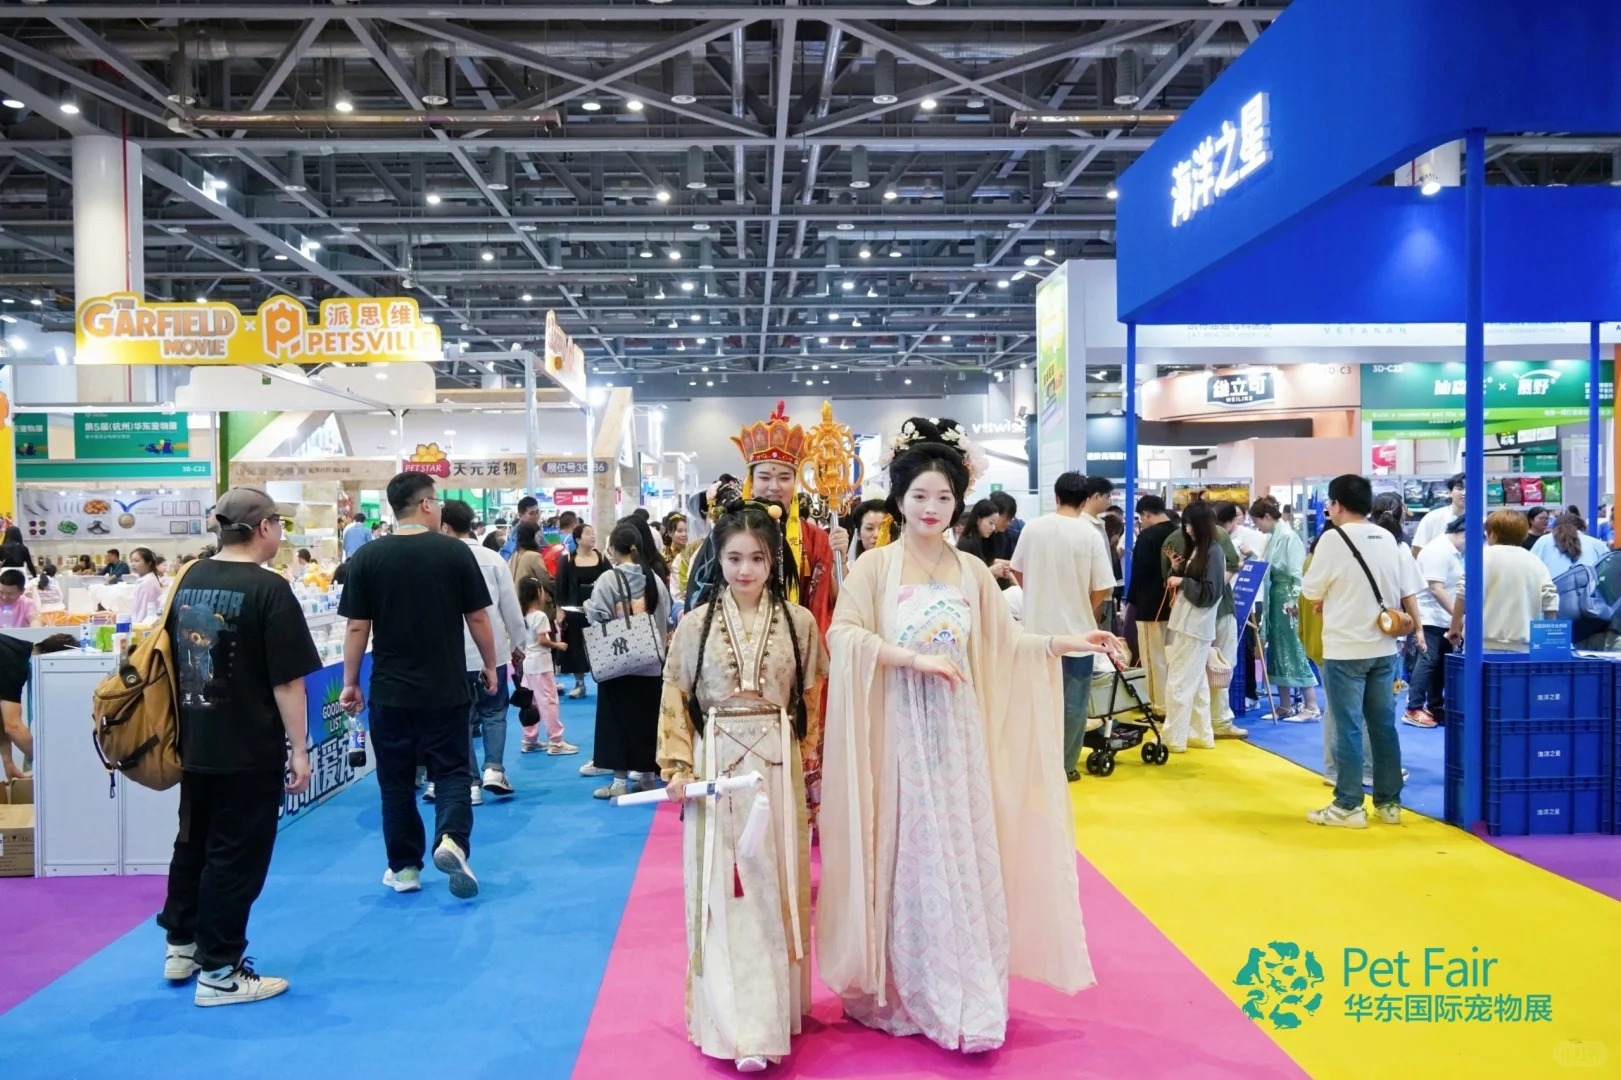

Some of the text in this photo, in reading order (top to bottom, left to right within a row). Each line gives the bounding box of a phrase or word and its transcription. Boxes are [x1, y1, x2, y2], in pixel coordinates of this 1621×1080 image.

[1171, 92, 1270, 227] 海洋之星
[113, 299, 135, 310] THE
[83, 303, 236, 338] GARFIELD
[328, 304, 412, 326] 派思维
[163, 338, 225, 356] MOVIE
[308, 331, 432, 353] PETSVILL
[1225, 395, 1254, 403] WEILIKE
[453, 461, 517, 476] 天元宠物
[546, 462, 605, 474] 展位号3CB6
[1537, 693, 1561, 701] 海洋之星
[329, 715, 342, 732] LIST
[1537, 750, 1561, 758] 海洋之星
[1537, 808, 1561, 816] 海洋之星
